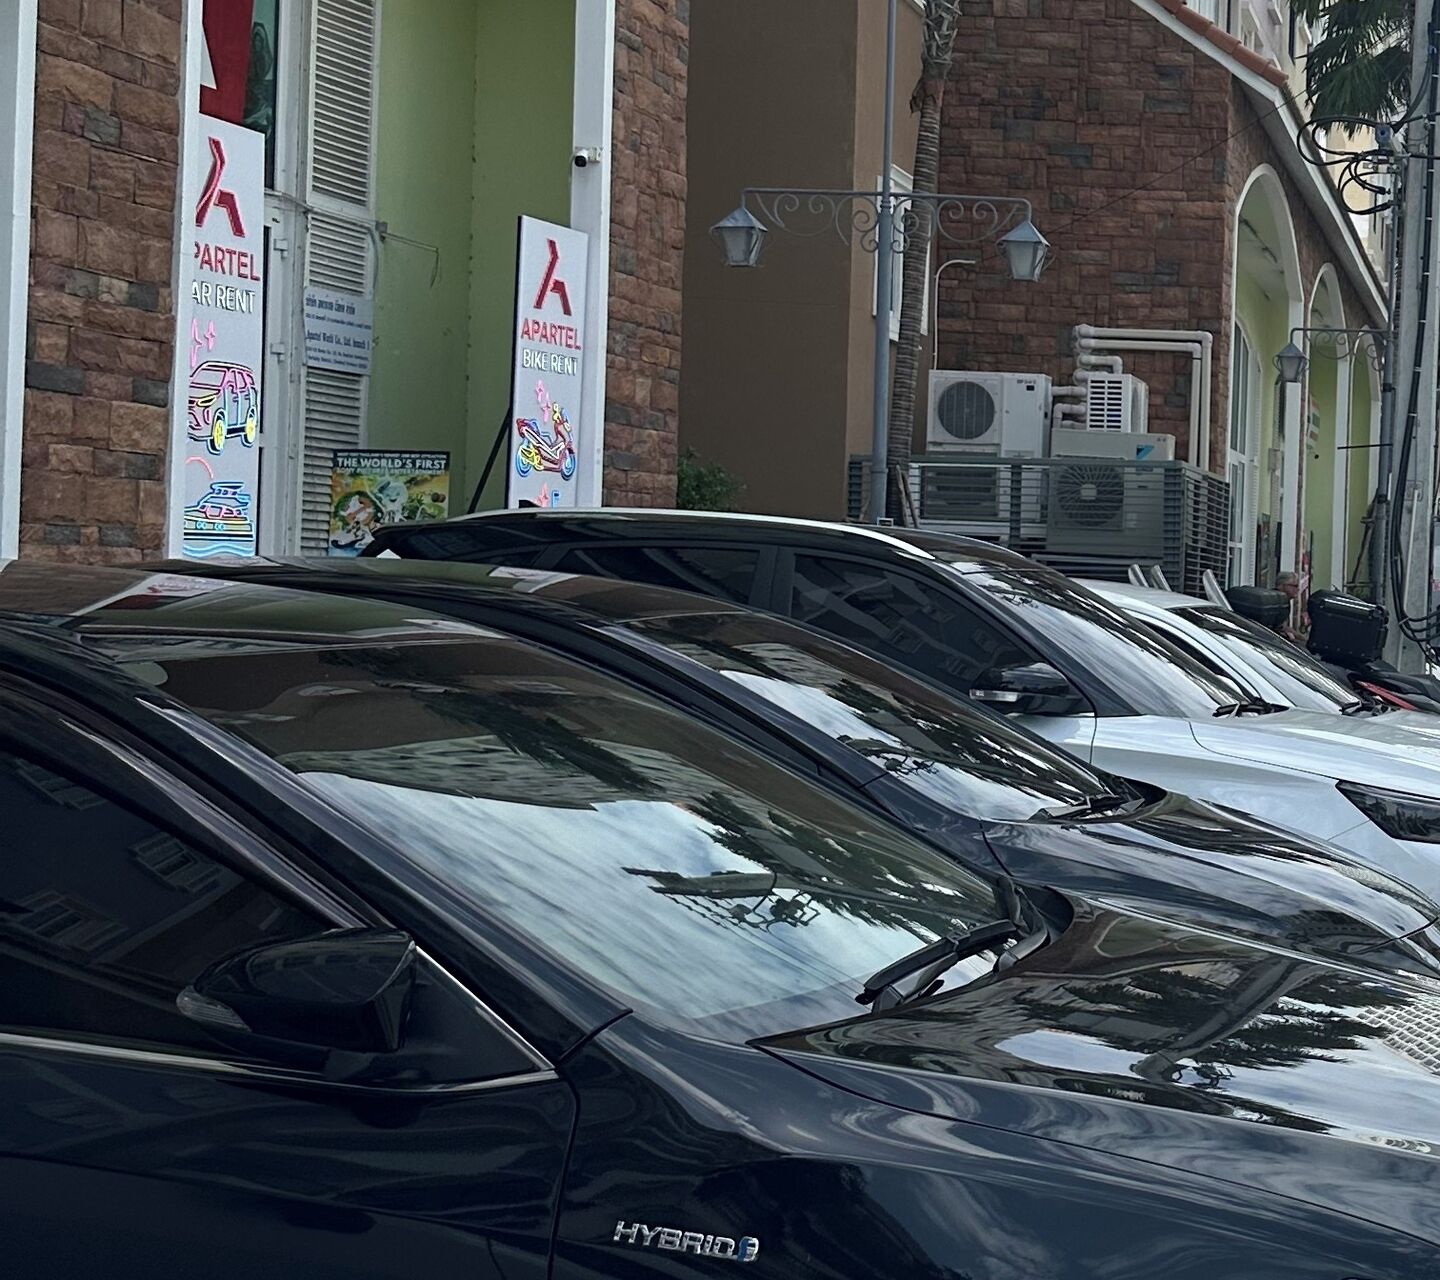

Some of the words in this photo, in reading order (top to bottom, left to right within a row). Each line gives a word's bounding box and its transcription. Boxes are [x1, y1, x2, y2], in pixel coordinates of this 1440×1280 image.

[215, 283, 256, 314] RENT
[520, 318, 582, 351] APARTEL
[522, 347, 548, 372] BIKE
[550, 352, 579, 377] RENT
[337, 457, 358, 468] THE
[360, 458, 413, 469] WORLD'S
[415, 459, 447, 470] FIRST
[612, 1221, 736, 1257] HYBRID
